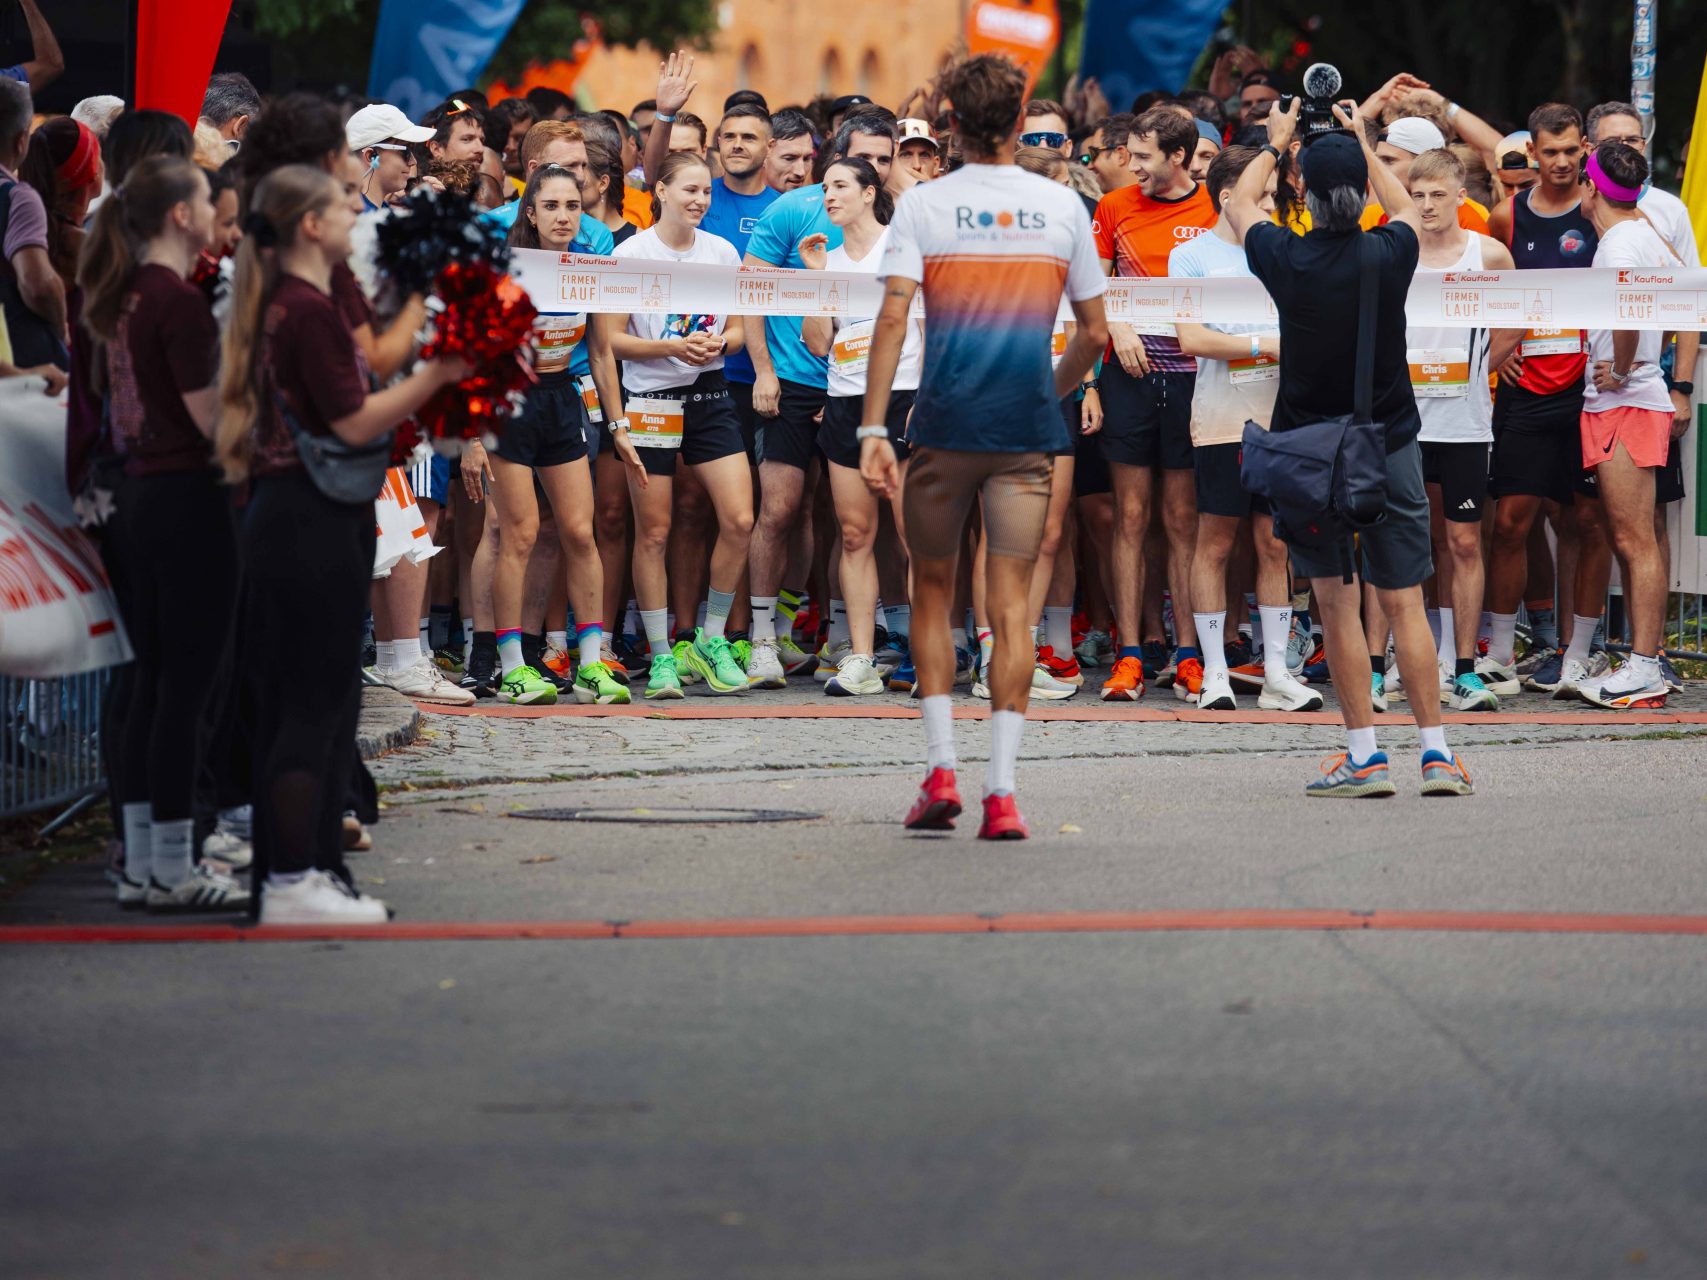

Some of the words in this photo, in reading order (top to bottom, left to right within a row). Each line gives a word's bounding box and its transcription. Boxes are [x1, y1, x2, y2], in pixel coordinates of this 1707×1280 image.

[577, 258, 618, 266] Kaufland
[562, 275, 596, 284] FIRMEN
[1634, 276, 1673, 284] Kaufland
[603, 286, 638, 294] INGOLSTADT
[739, 281, 774, 290] FIRMEN
[562, 287, 596, 300] LAUF
[781, 291, 816, 299] INGOLSTADT
[1104, 289, 1128, 297] RMEN
[1445, 292, 1479, 301] FIRMEN
[740, 293, 773, 305] LAUF
[1620, 294, 1653, 303] FIRMEN
[1446, 304, 1479, 316] LAUF
[1620, 306, 1653, 318] LAUF
[543, 330, 576, 340] Antonia
[1422, 364, 1447, 374] Chris
[640, 414, 665, 424] Anna
